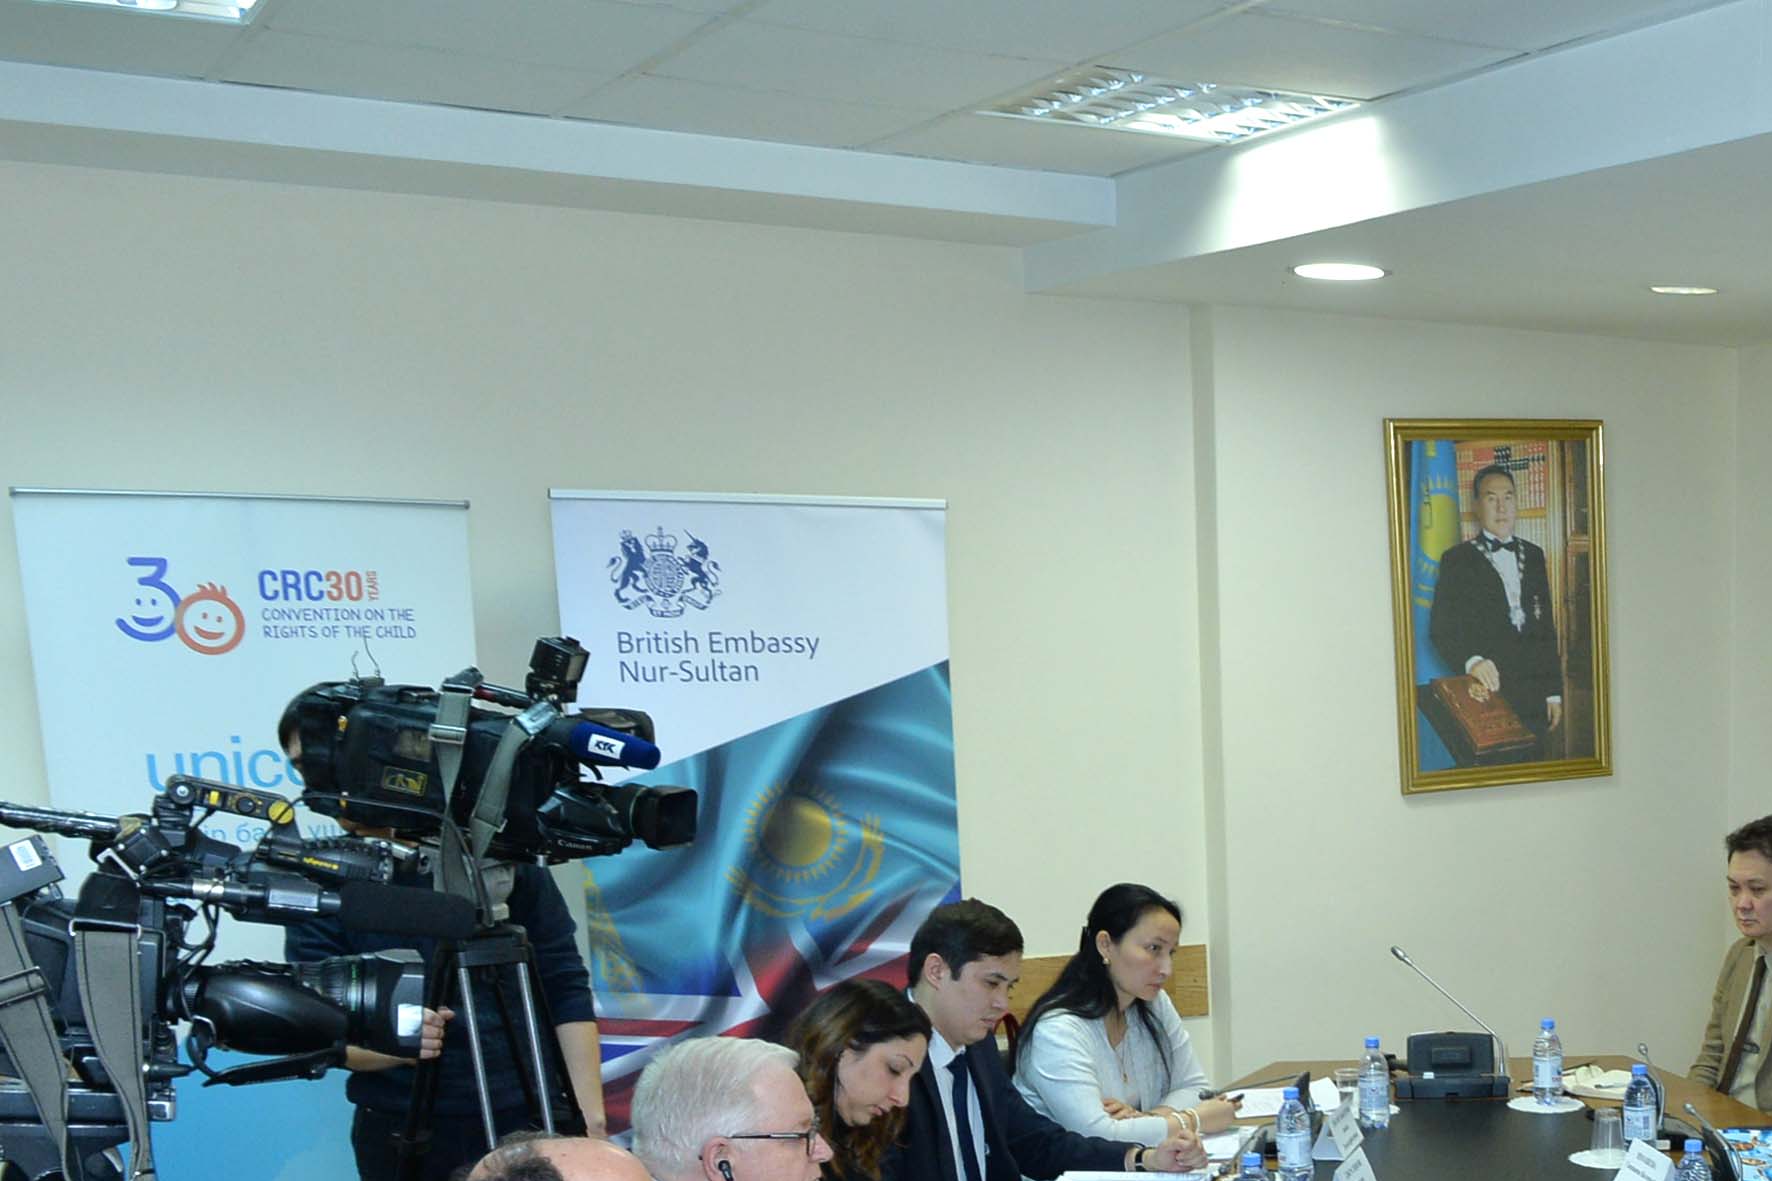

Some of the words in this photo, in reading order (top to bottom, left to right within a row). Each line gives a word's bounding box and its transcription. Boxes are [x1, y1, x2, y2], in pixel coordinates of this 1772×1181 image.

[262, 607, 362, 622] CONVENTION
[364, 607, 385, 622] ON
[388, 607, 415, 622] THE
[263, 625, 318, 639] RIGHTS
[321, 625, 341, 639] OF
[343, 625, 372, 639] THE
[375, 625, 416, 639] CHILD
[617, 630, 699, 655] British
[708, 630, 820, 659] Embassy
[619, 659, 759, 683] Nur-Sultan
